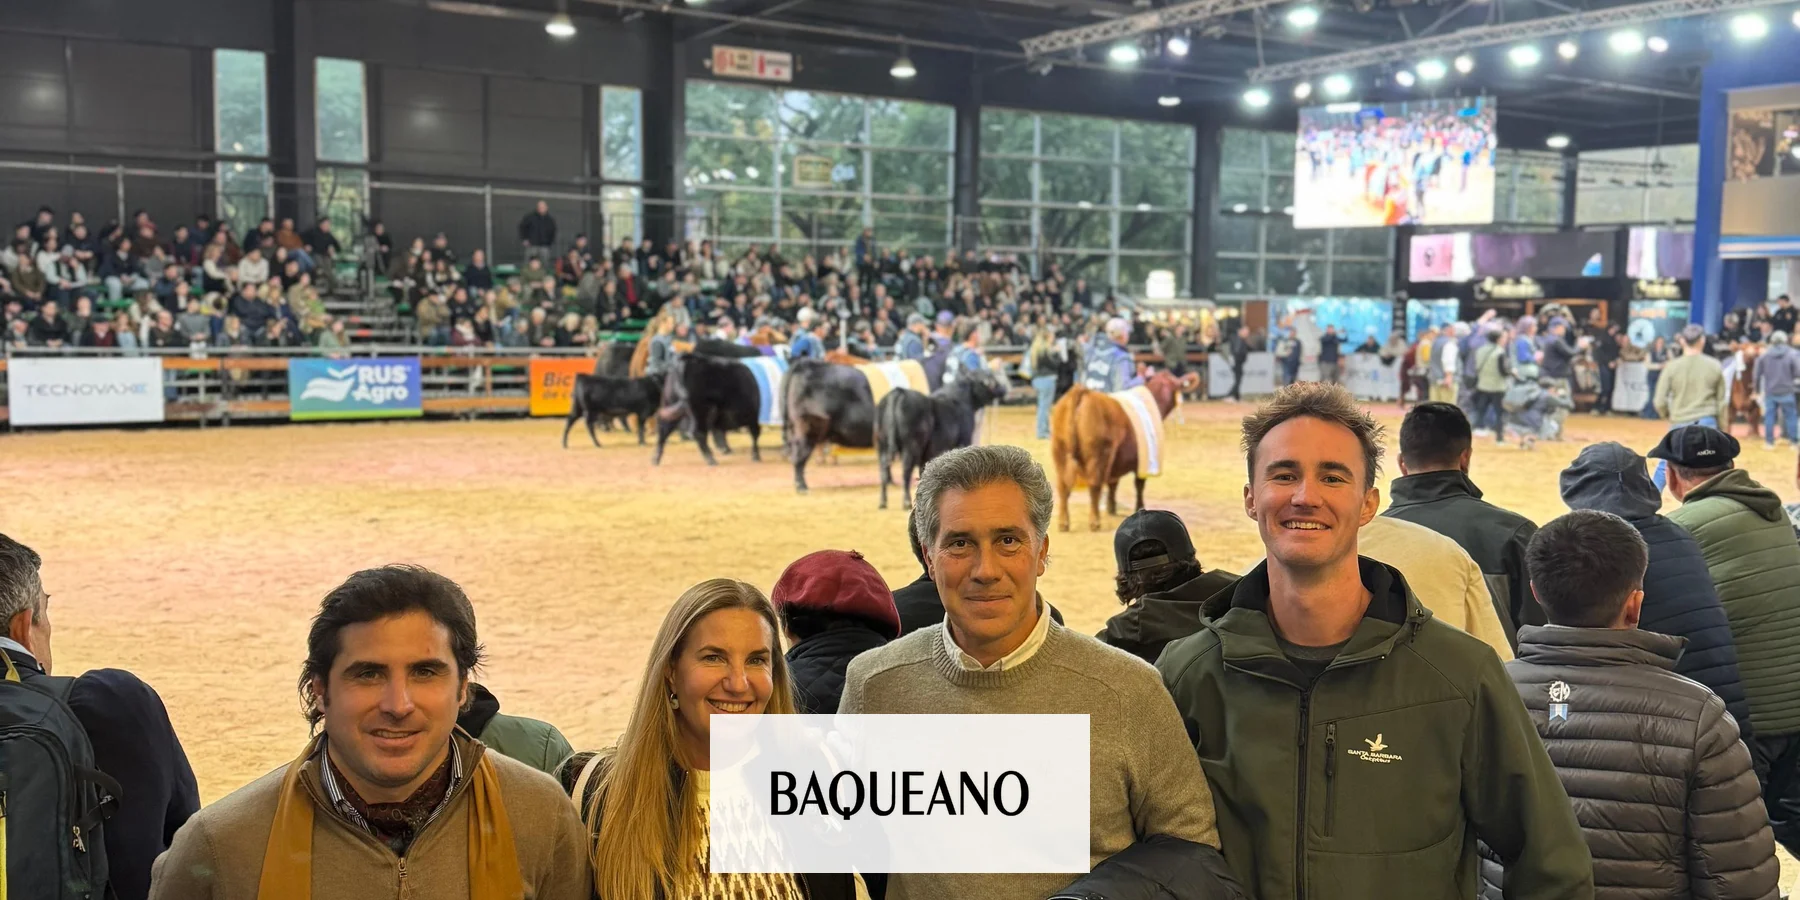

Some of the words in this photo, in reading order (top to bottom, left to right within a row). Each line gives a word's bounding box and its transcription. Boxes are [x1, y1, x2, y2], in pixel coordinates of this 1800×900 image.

[358, 365, 407, 385] RUS
[352, 383, 409, 404] Agro
[1347, 749, 1369, 757] SANTA
[1370, 752, 1403, 761] BARBARA
